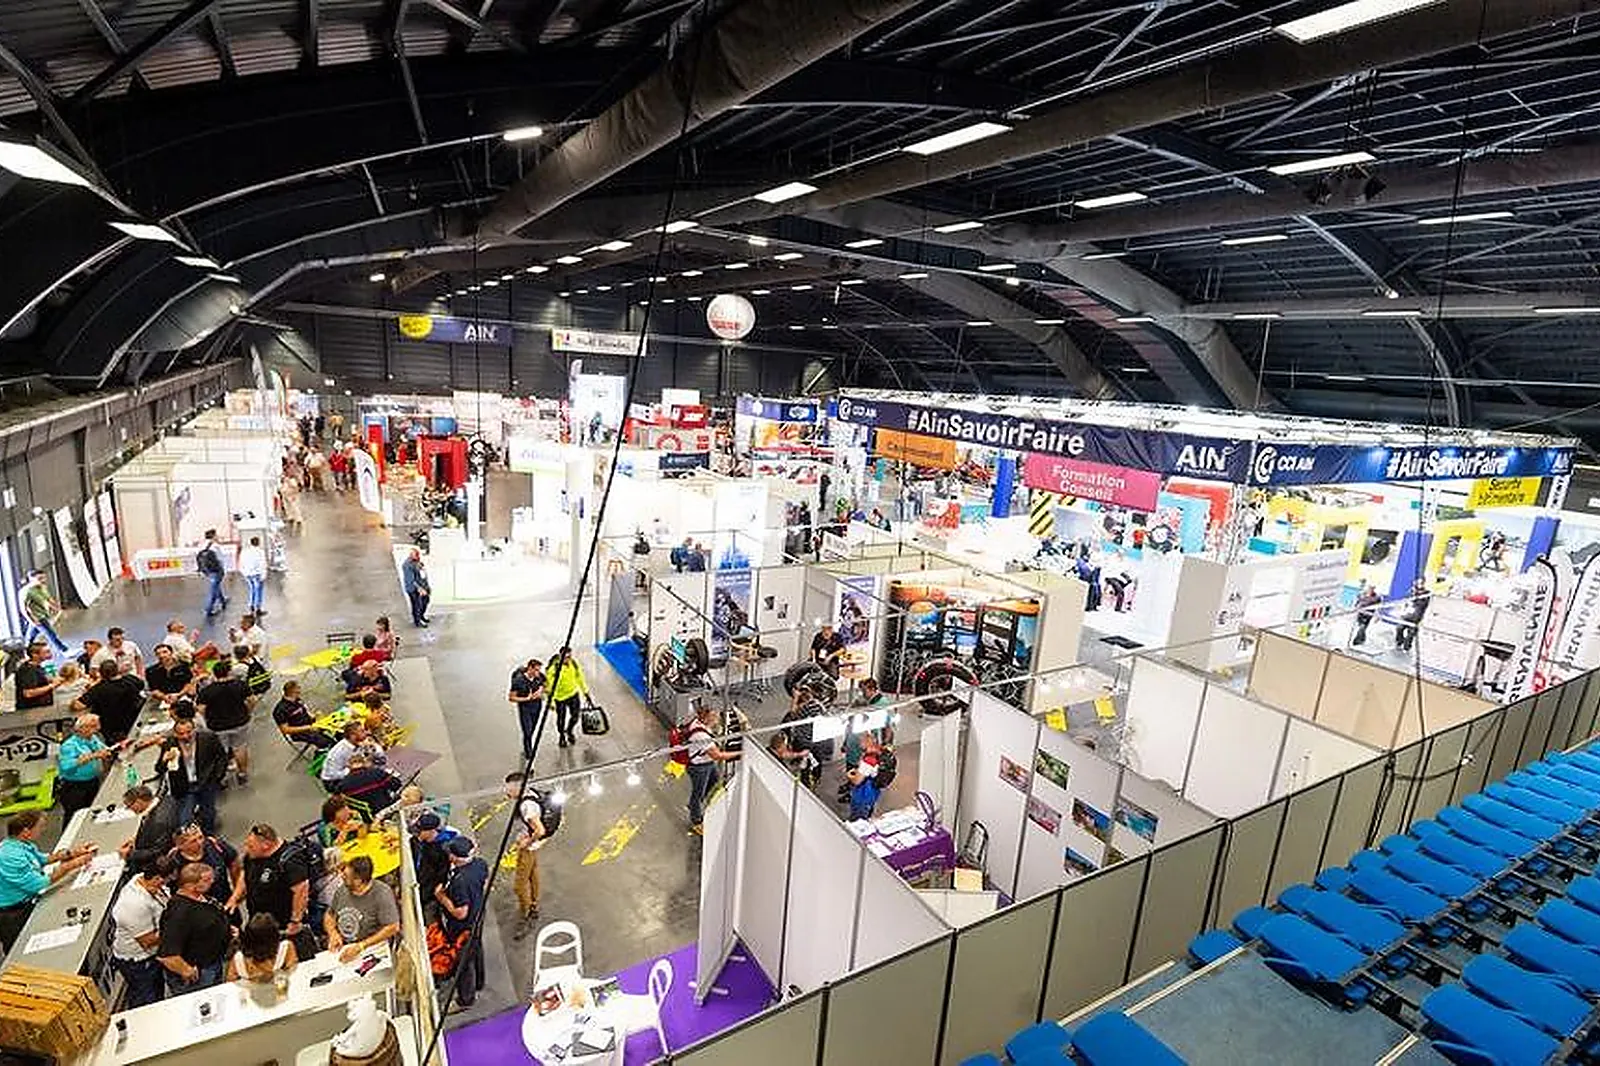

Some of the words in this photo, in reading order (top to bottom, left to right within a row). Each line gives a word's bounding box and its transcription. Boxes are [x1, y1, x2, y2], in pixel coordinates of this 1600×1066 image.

[464, 323, 498, 341] AIN
[907, 409, 1085, 456] #AinSavoirFaire
[1176, 444, 1226, 471] AIN
[1052, 465, 1126, 490] Formation
